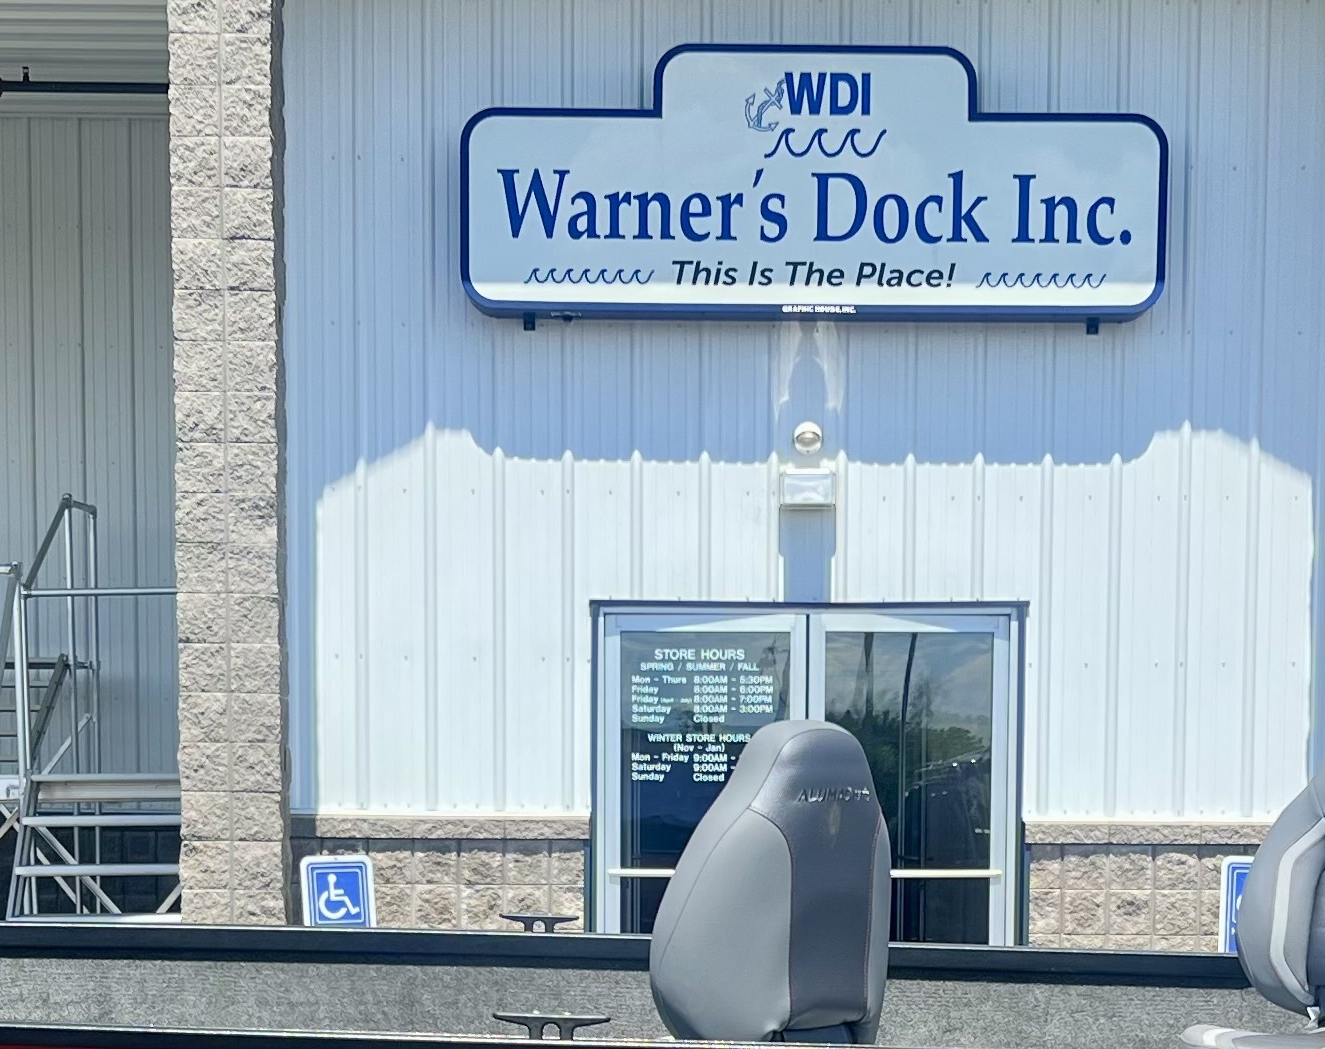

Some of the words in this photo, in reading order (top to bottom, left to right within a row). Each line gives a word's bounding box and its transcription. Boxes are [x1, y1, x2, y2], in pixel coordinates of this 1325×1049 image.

[784, 72, 872, 117] WDI
[497, 167, 788, 244] Warner's
[810, 170, 990, 245] Dock
[1011, 174, 1133, 246] Inc.
[672, 260, 741, 287] This
[748, 262, 774, 287] Is
[785, 261, 846, 288] The
[856, 262, 956, 289] Place!
[655, 649, 695, 660] STORE
[701, 649, 745, 661] HOURS
[640, 662, 674, 671] SPRING
[686, 662, 726, 671] SUMMER
[738, 662, 759, 671] FALL
[631, 675, 651, 684] Mon
[631, 685, 659, 694] Friday
[631, 695, 659, 704] Friday
[631, 705, 672, 714] Saturday
[631, 714, 665, 724] Sunday
[693, 714, 725, 723] Closed
[647, 733, 683, 742] WINTER
[685, 733, 716, 742] STORE
[719, 733, 751, 742] HOURS
[673, 743, 694, 752] (Nov
[705, 743, 725, 752] Jan)
[631, 753, 651, 761] Mon
[661, 753, 689, 763] Friday
[631, 763, 672, 772] Saturday
[631, 772, 665, 782] Sunday
[693, 773, 725, 782] Closed
